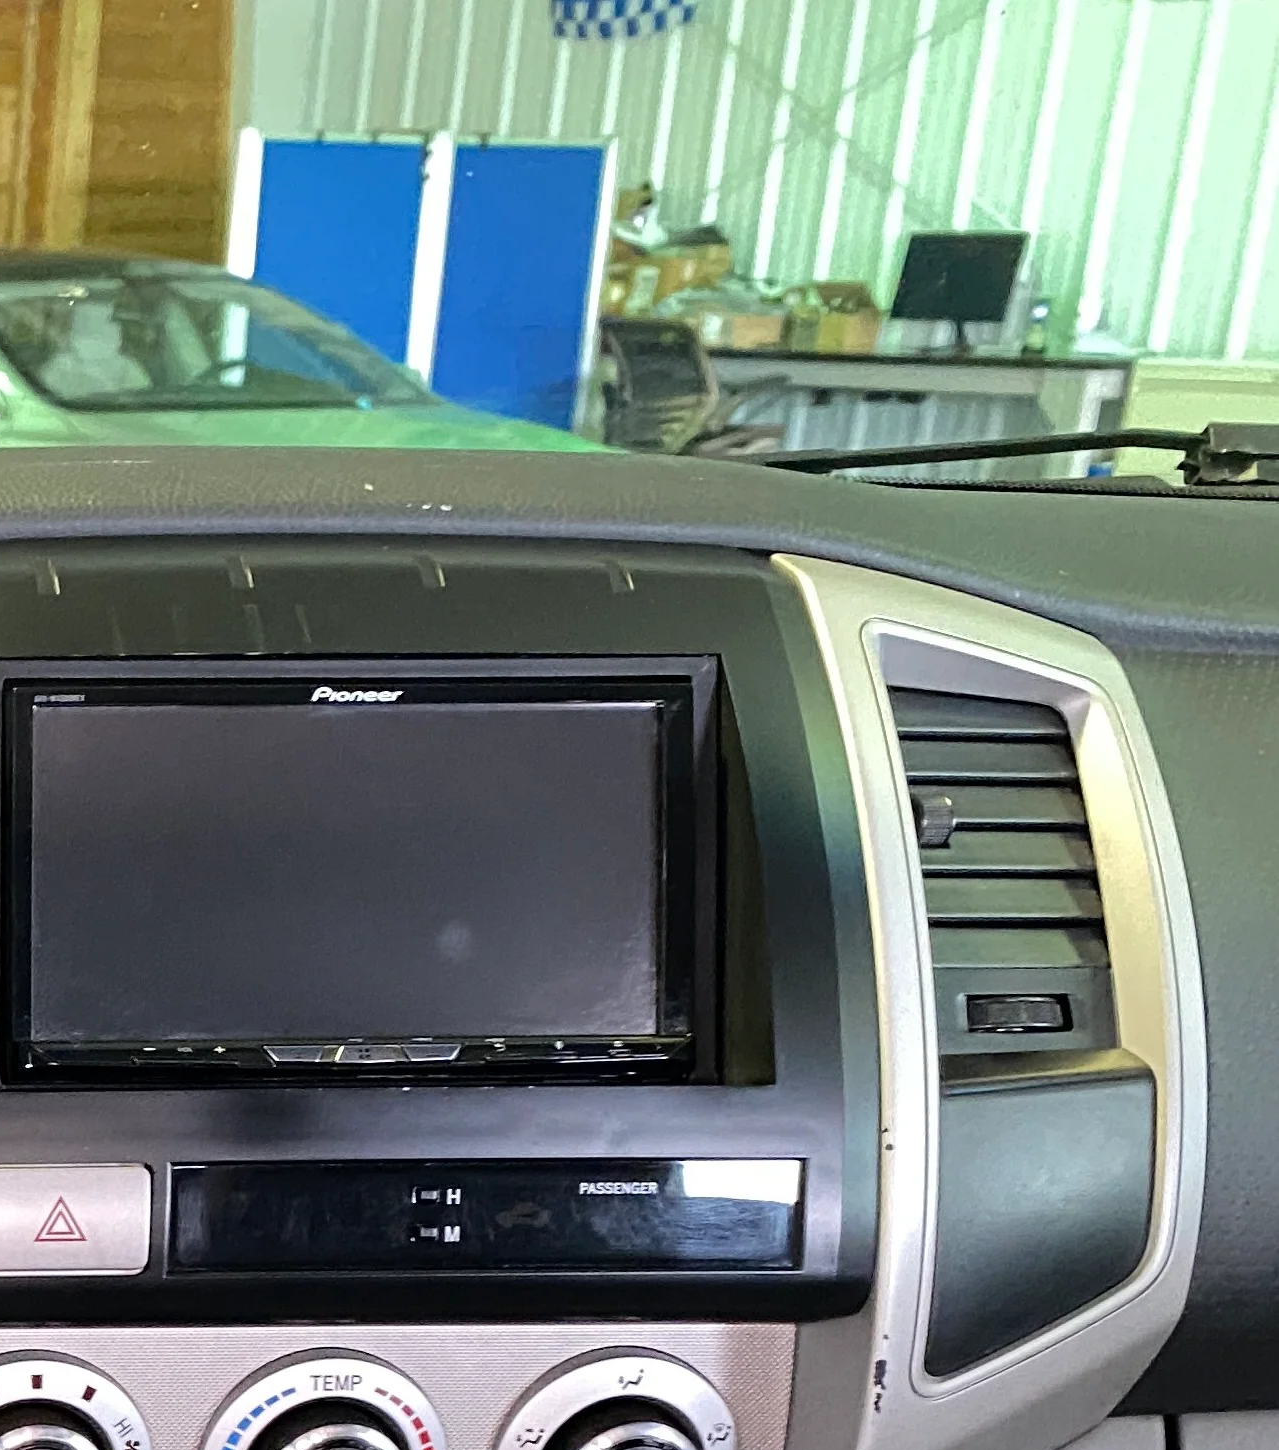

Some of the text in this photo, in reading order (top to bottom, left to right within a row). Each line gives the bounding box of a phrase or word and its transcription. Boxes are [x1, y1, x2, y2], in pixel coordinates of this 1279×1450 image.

[311, 686, 402, 703] Pioneer
[579, 1182, 658, 1196] PASSENGER
[309, 1374, 363, 1392] TEMP
[112, 1417, 134, 1438] HI
